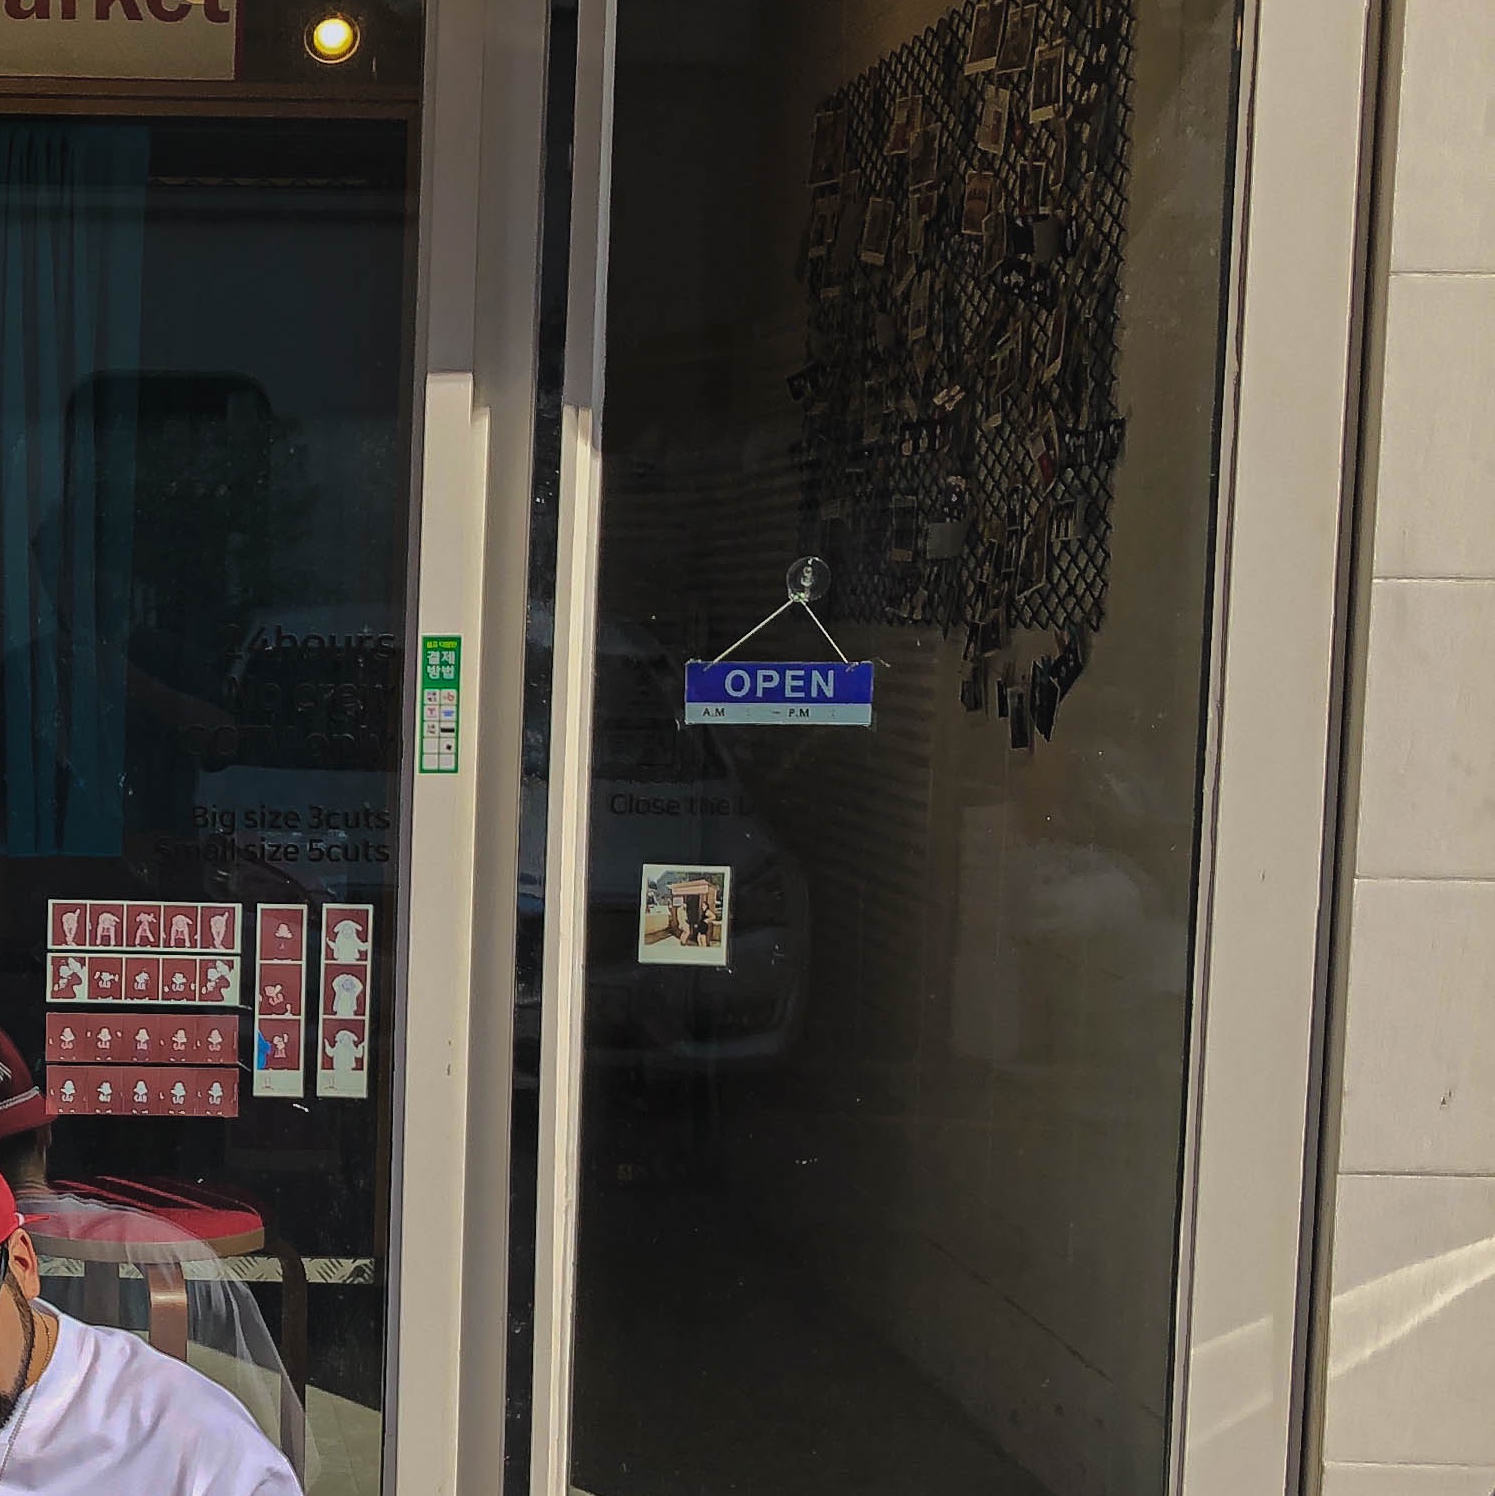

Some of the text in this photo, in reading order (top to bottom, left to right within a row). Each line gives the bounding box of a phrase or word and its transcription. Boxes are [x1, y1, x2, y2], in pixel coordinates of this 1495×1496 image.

[426, 650, 456, 665] 결제
[426, 665, 455, 680] 방법
[724, 669, 835, 698] OPEN
[609, 793, 681, 817] Close
[688, 793, 730, 817] the
[192, 804, 391, 836] Big size 3cuts
[246, 838, 301, 863] size
[307, 838, 391, 863] 5cuts
